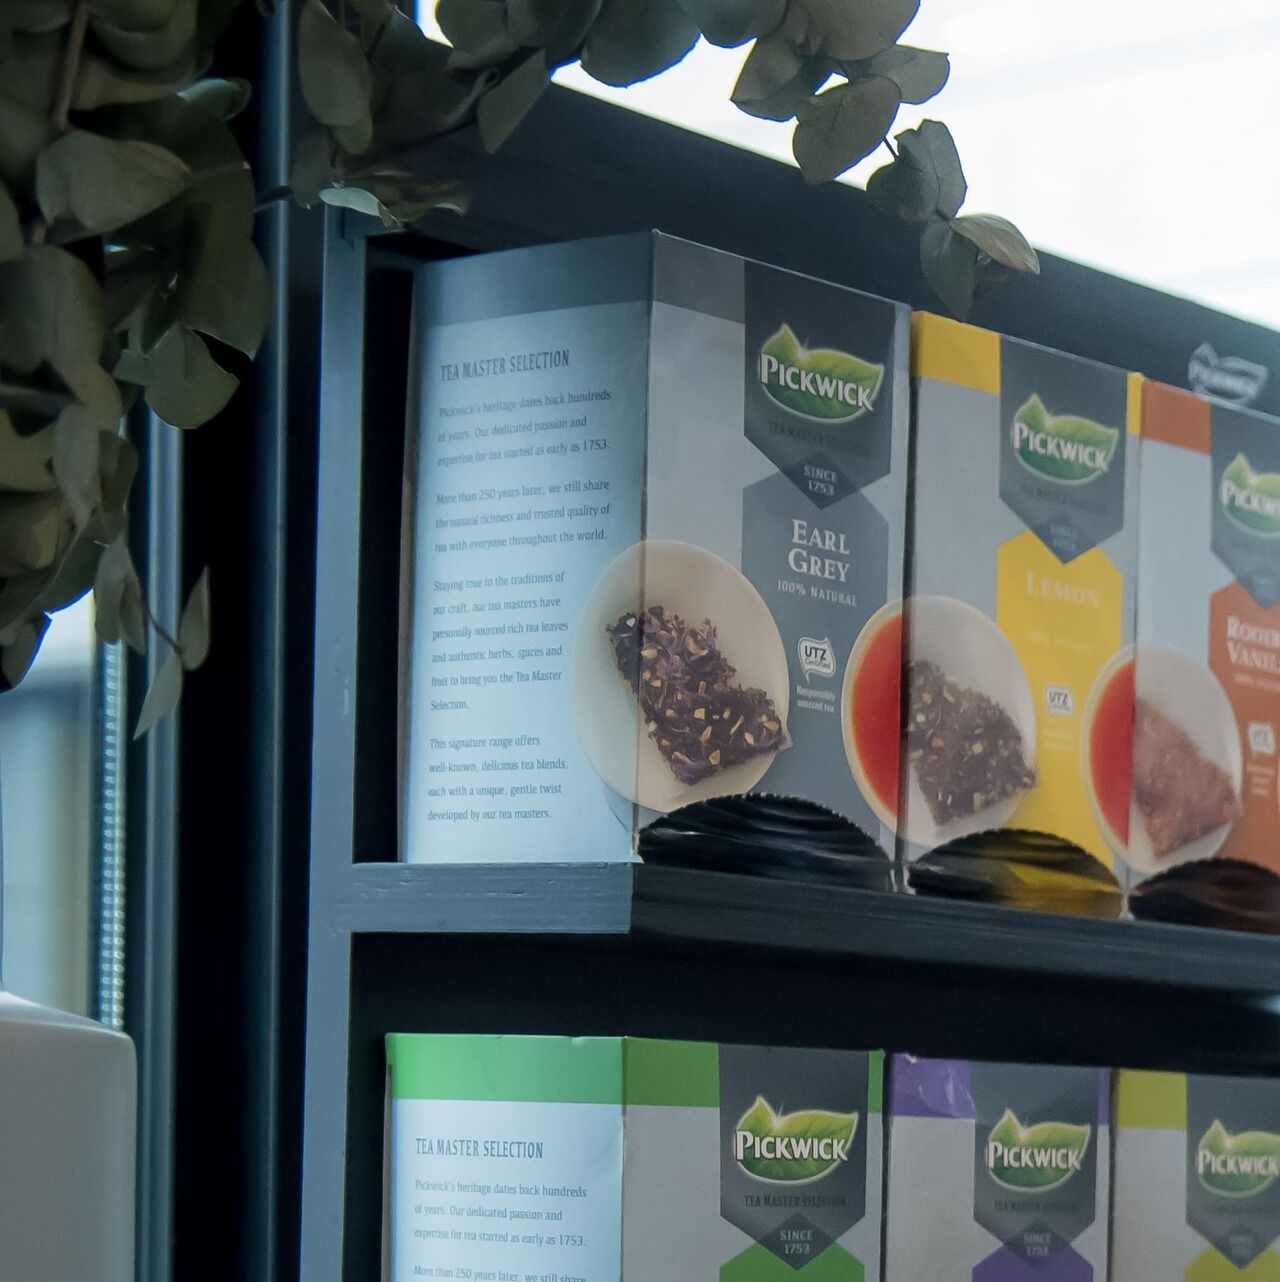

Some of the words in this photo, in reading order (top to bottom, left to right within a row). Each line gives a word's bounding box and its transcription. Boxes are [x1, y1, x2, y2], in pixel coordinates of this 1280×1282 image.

[441, 365, 459, 381] TEA
[462, 357, 506, 378] MASTER
[510, 350, 570, 372] SELECTION
[760, 354, 873, 411] PICKWICK
[1013, 422, 1109, 472] PICKWICK
[804, 465, 837, 483] SINCE
[808, 480, 834, 495] 1753
[792, 519, 850, 555] EARL
[788, 548, 850, 582] GREY
[777, 580, 806, 595] 100%
[811, 587, 857, 607] NATURAL
[804, 646, 826, 661] UTZ
[1049, 690, 1069, 705] UTZ
[430, 739, 446, 749] This
[449, 737, 487, 750] signature
[489, 738, 512, 748] range
[515, 735, 540, 746] offers
[482, 760, 518, 771] delicious
[537, 758, 568, 770] blends,
[428, 786, 446, 796] each
[449, 785, 466, 796] with
[477, 786, 506, 797] unique,
[510, 784, 537, 797] gentle
[540, 784, 562, 794] twist
[428, 810, 468, 822] developed
[471, 809, 480, 822] by
[482, 811, 497, 819] our
[499, 810, 512, 819] tea
[514, 809, 551, 819] masters.
[416, 1138, 433, 1155] TEA
[436, 1139, 479, 1157] MASTER
[483, 1141, 544, 1159] SELECTION
[736, 1131, 848, 1161] PICKWICK
[987, 1141, 1080, 1170] PICKWICK
[1198, 1150, 1280, 1177] PICKWICK
[457, 1182, 491, 1196] heritage
[494, 1183, 517, 1194] dates
[519, 1183, 539, 1195] back
[542, 1184, 587, 1197] hundreds
[415, 1204, 422, 1214] of
[450, 1206, 464, 1216] Our
[466, 1206, 507, 1218] dedicated
[510, 1210, 542, 1221] passion
[545, 1210, 562, 1221] and
[450, 1229, 461, 1239] for
[464, 1231, 476, 1240] tea
[479, 1232, 508, 1242] started
[511, 1235, 519, 1243] as
[522, 1233, 543, 1247] early
[546, 1236, 556, 1245] as
[559, 1235, 586, 1246] 1753.
[781, 1230, 812, 1240] SINCE
[785, 1243, 809, 1254] 1753
[414, 1265, 433, 1276] More
[436, 1266, 453, 1278] than
[455, 1268, 472, 1279] 250
[474, 1270, 496, 1282] years
[498, 1270, 521, 1282] later,
[525, 1275, 537, 1282] we
